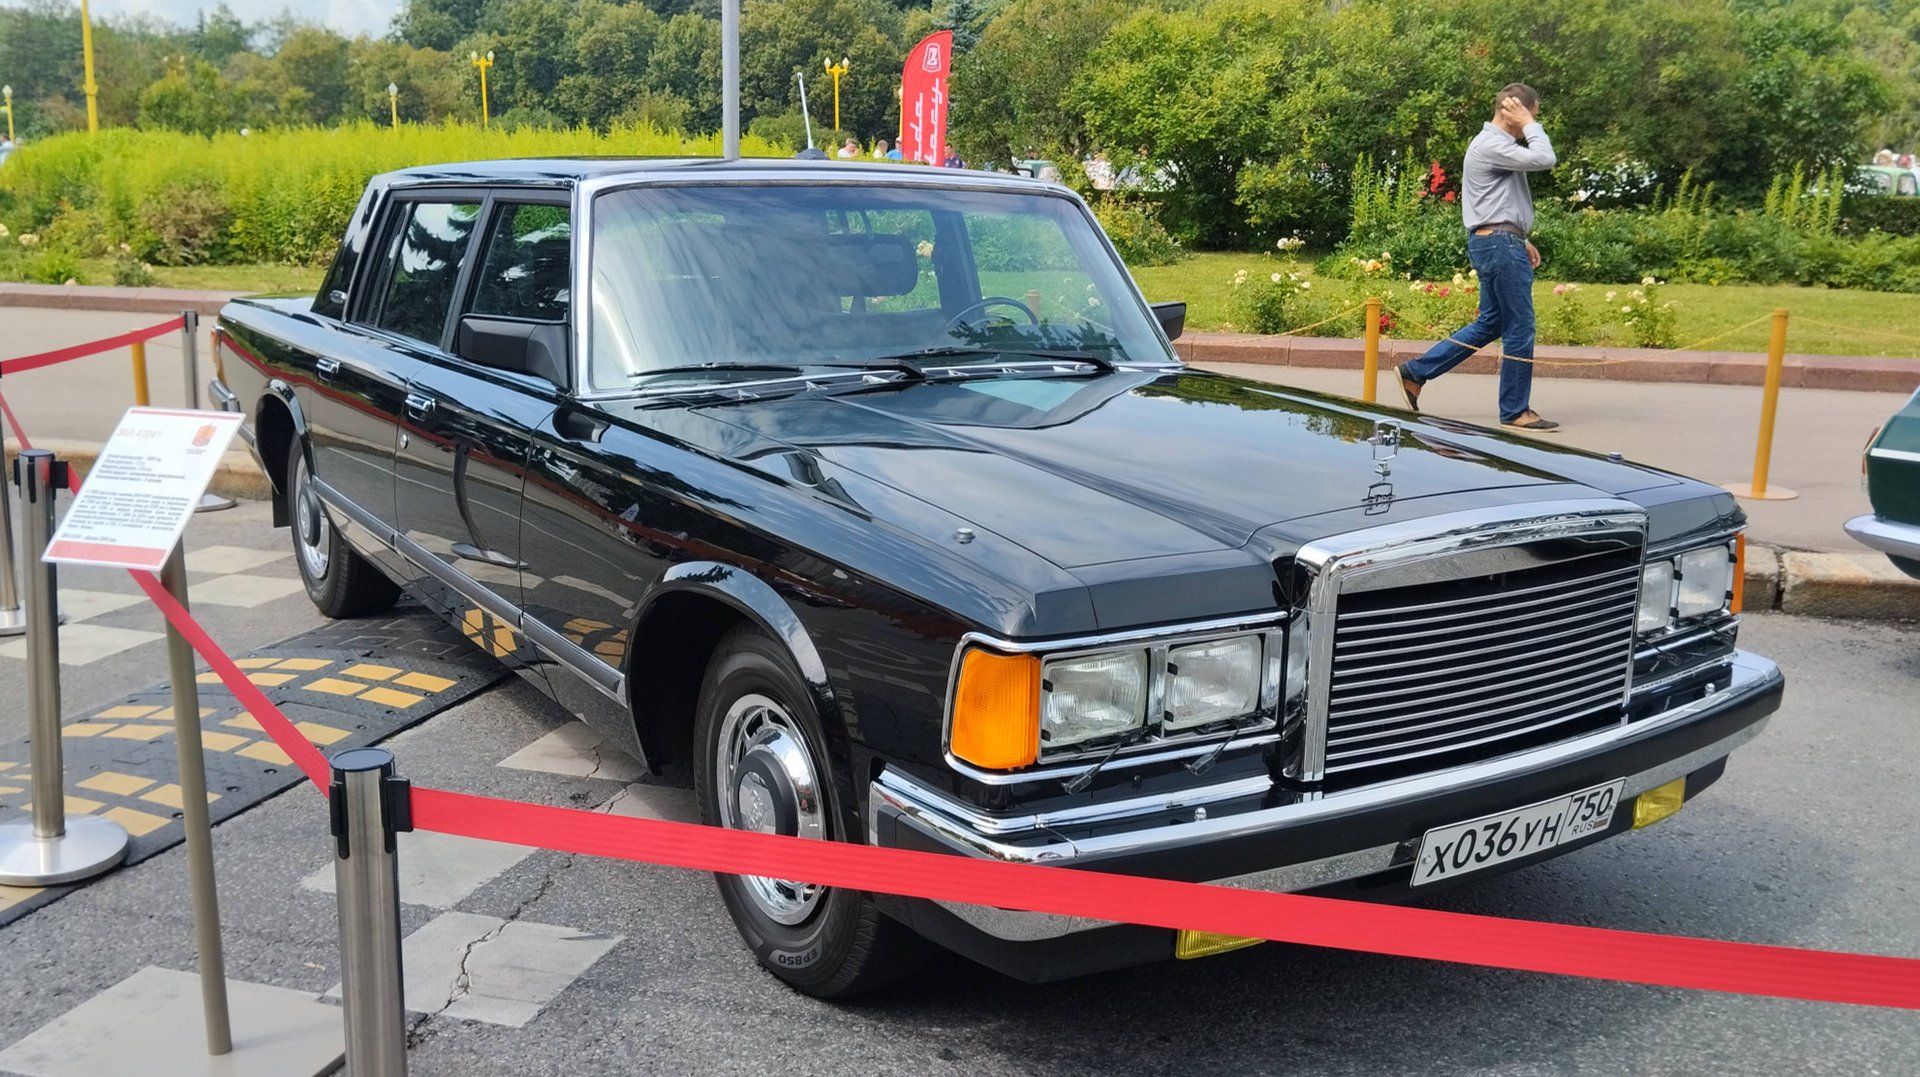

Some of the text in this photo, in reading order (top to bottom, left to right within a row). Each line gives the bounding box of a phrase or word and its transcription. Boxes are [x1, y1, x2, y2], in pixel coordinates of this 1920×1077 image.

[909, 92, 923, 161] ada
[1567, 787, 1614, 827] 750
[1571, 820, 1594, 836] RUS
[778, 948, 818, 966] EP850
